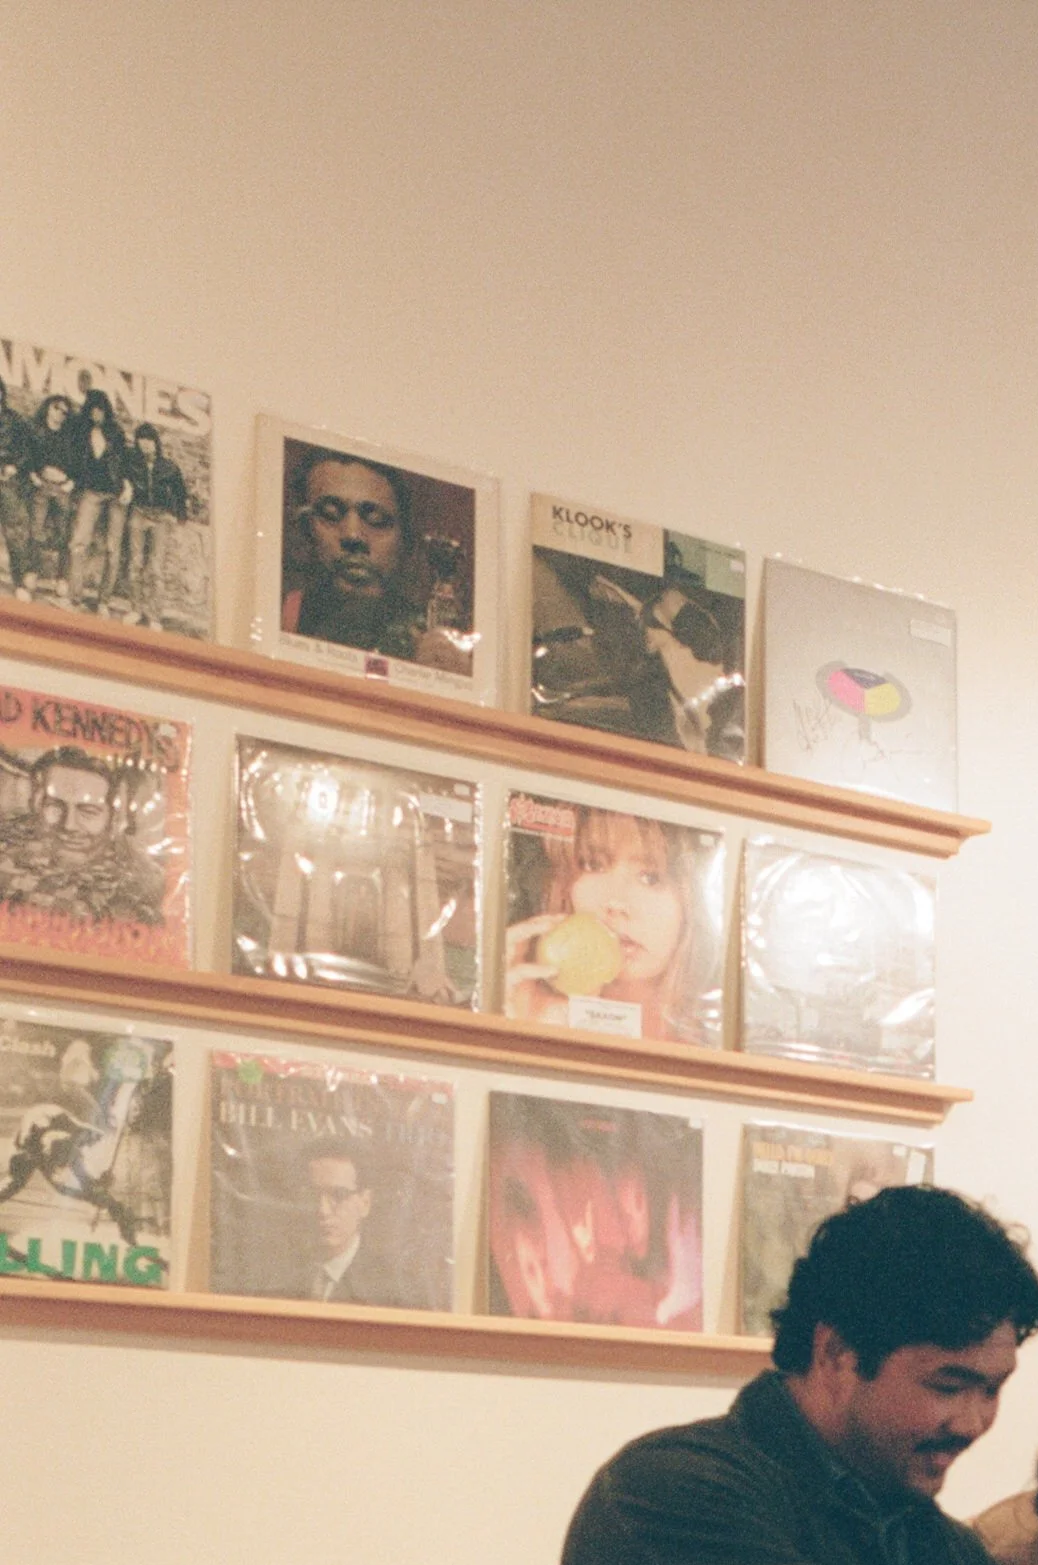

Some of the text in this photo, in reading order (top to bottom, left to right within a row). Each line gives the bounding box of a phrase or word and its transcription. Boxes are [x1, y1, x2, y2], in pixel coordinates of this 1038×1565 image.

[0, 334, 211, 436] MONES
[551, 504, 634, 540] KLOOK'S
[31, 697, 181, 773] KENNEDYS
[219, 1100, 284, 1130] BILL
[290, 1106, 376, 1138] EVANS
